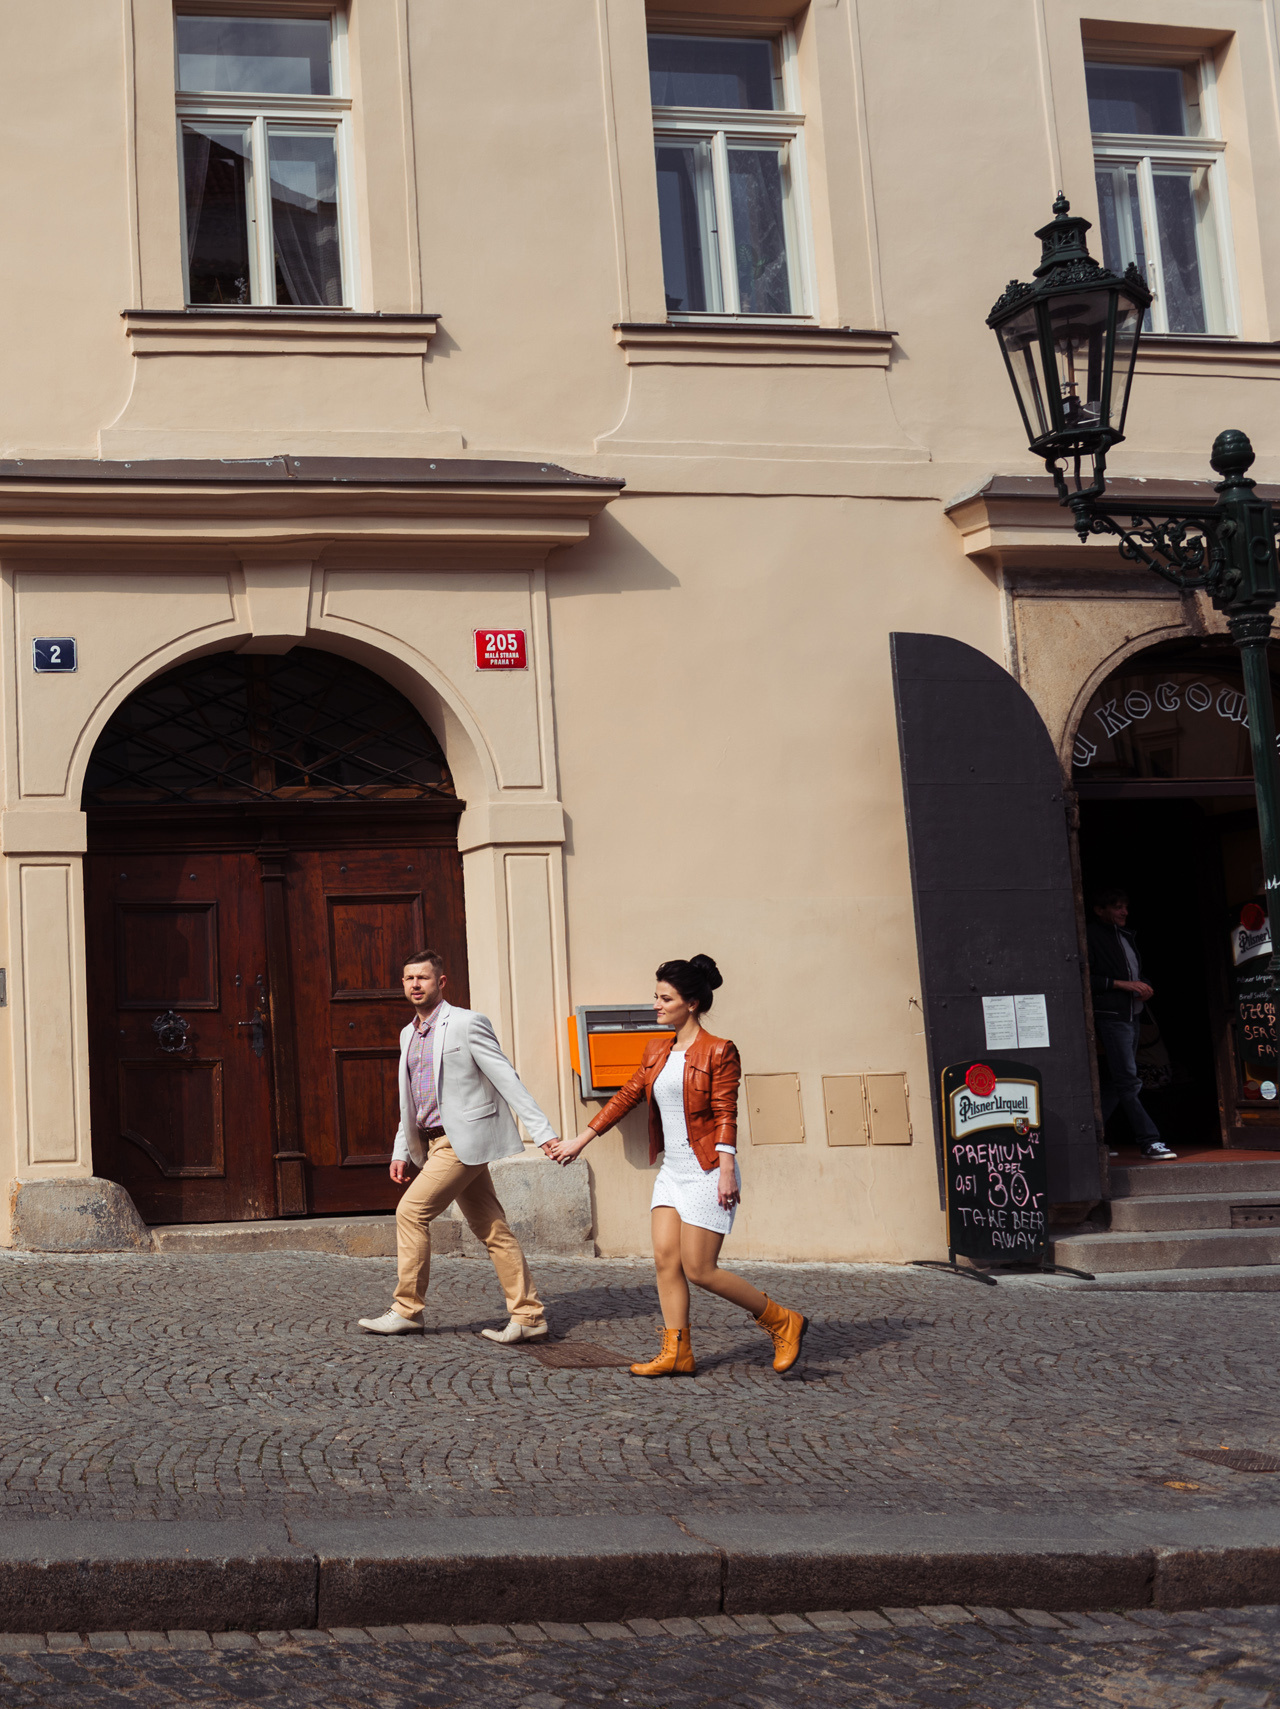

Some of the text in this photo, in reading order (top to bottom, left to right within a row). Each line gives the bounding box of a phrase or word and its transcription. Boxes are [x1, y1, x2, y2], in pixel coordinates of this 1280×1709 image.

[485, 633, 518, 651] 205
[50, 645, 61, 663] 2
[1093, 682, 1250, 739] KOCOU
[959, 1095, 1028, 1123] Pilsner Urquell
[953, 1142, 1035, 1166] PREMIUM
[987, 1161, 1026, 1174] KOZEL
[958, 1207, 1045, 1235] TAKE BEER
[991, 1230, 1037, 1252] AWAY
